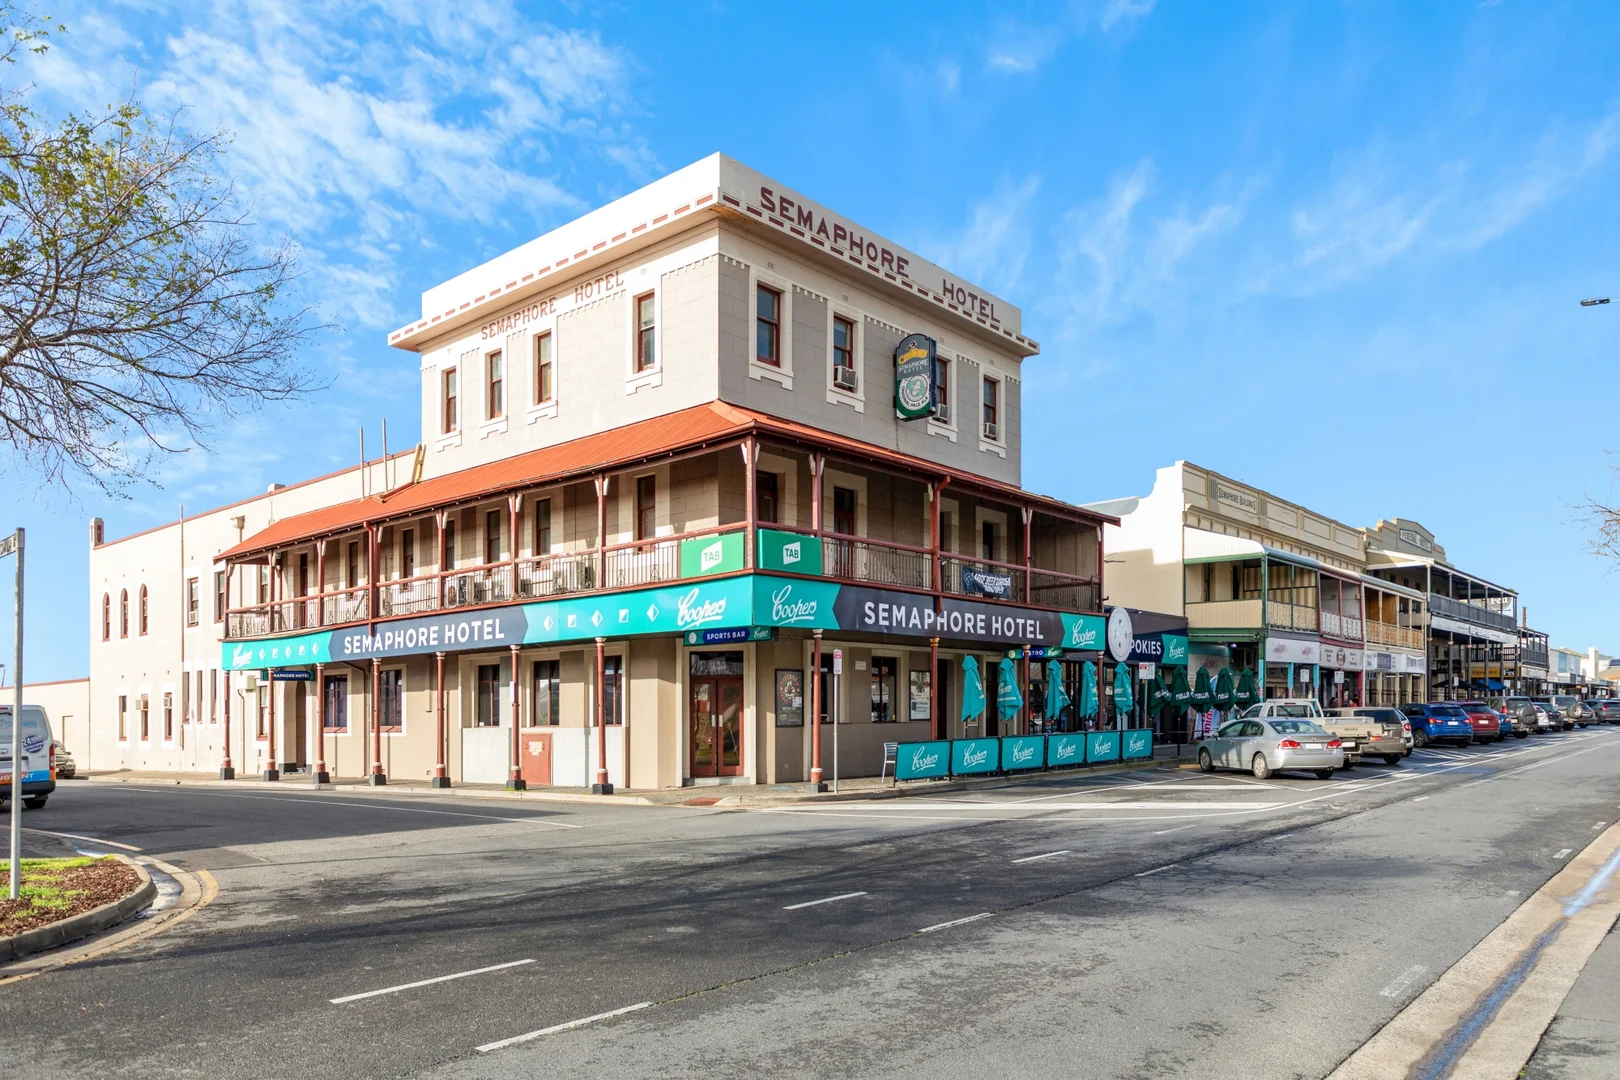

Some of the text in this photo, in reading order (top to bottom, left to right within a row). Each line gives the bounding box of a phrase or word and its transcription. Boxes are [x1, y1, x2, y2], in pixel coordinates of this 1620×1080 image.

[760, 186, 1001, 324] SEMAPHORE HOTEL
[481, 270, 625, 340] SEMAPHORE HOTEL
[703, 550, 720, 562] TAB
[784, 547, 799, 559] TAB
[677, 587, 726, 631] Coopers
[772, 584, 817, 626] Coopers
[864, 601, 1044, 640] SEMAPHORE HOTEL
[344, 618, 505, 654] SEMAPHORE HOTEL
[706, 631, 746, 641] SPORTS BAR
[1072, 619, 1097, 648] Coopers
[1129, 639, 1162, 655] POKIES
[1169, 639, 1185, 659] Coopers
[963, 742, 988, 768] Coopers
[1012, 740, 1034, 764] Coopers
[1056, 737, 1076, 761] Coopers
[1095, 735, 1112, 757] Coopers
[1129, 733, 1146, 755] Coopers
[912, 745, 938, 773] Coopers
